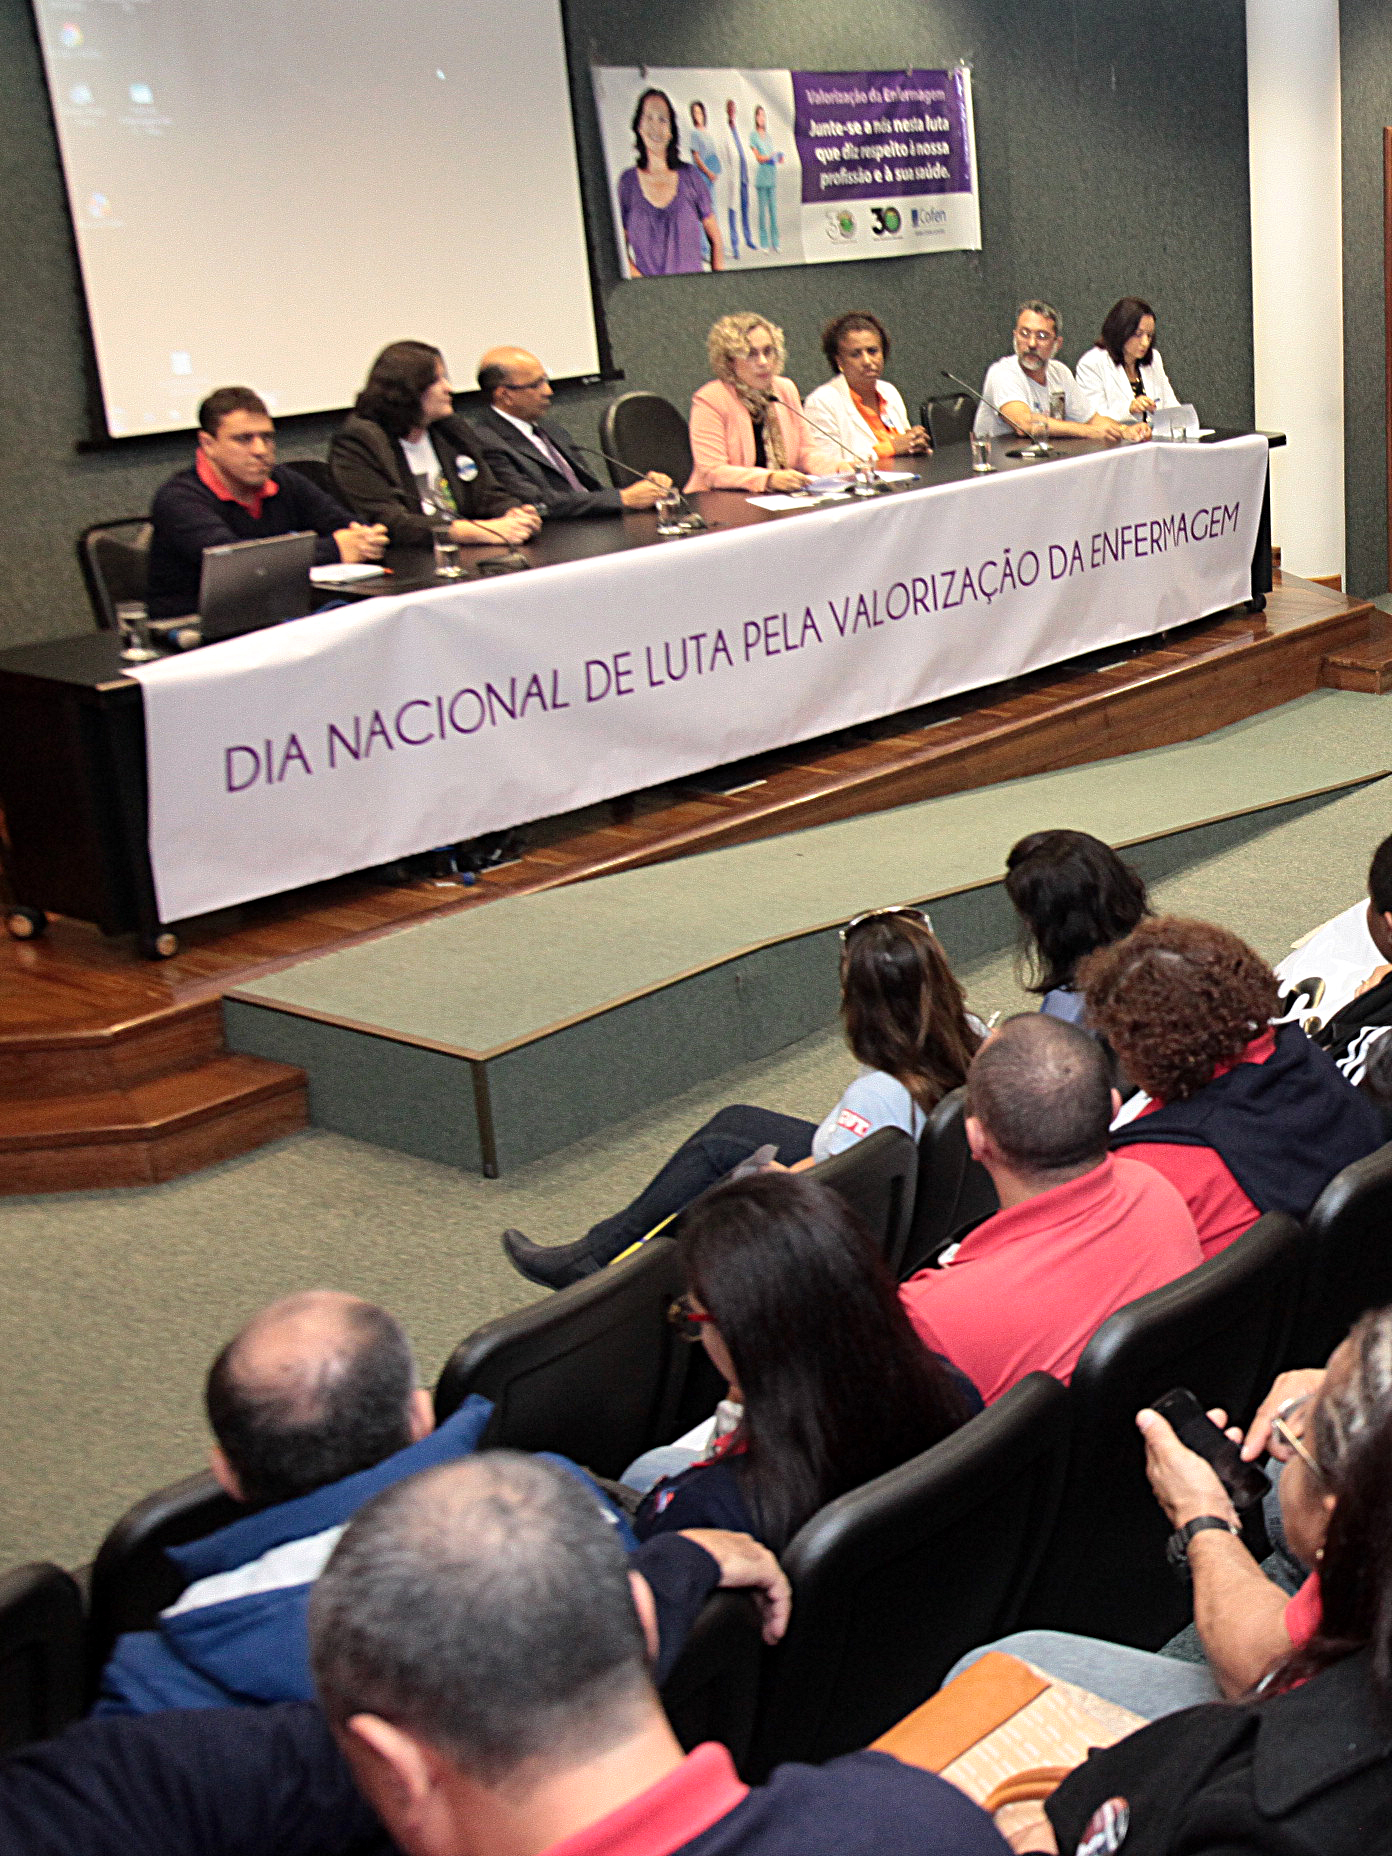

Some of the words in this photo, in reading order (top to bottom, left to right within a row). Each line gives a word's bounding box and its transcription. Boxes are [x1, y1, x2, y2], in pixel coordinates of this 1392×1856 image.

[868, 87, 883, 103] da
[809, 119, 863, 137] Junte-se
[863, 120, 873, 135] a
[873, 117, 893, 134] nós
[893, 116, 925, 133] nesta
[925, 113, 950, 132] luta
[815, 147, 841, 165] que
[842, 141, 860, 160] diz
[860, 140, 909, 162] respeito
[917, 141, 950, 156] nossa
[820, 166, 873, 190] profissão
[873, 169, 883, 183] e
[884, 164, 894, 182] à
[894, 167, 915, 182] sua
[224, 732, 313, 793] DIA
[328, 669, 570, 768] NACIONAL
[585, 651, 635, 704] DE
[645, 628, 735, 688] LUTA
[742, 606, 823, 663] PELA
[828, 548, 1040, 637] VALORIZAÇÃO
[1048, 541, 1085, 581] DA
[1090, 501, 1241, 569] ENFERMAGEM
